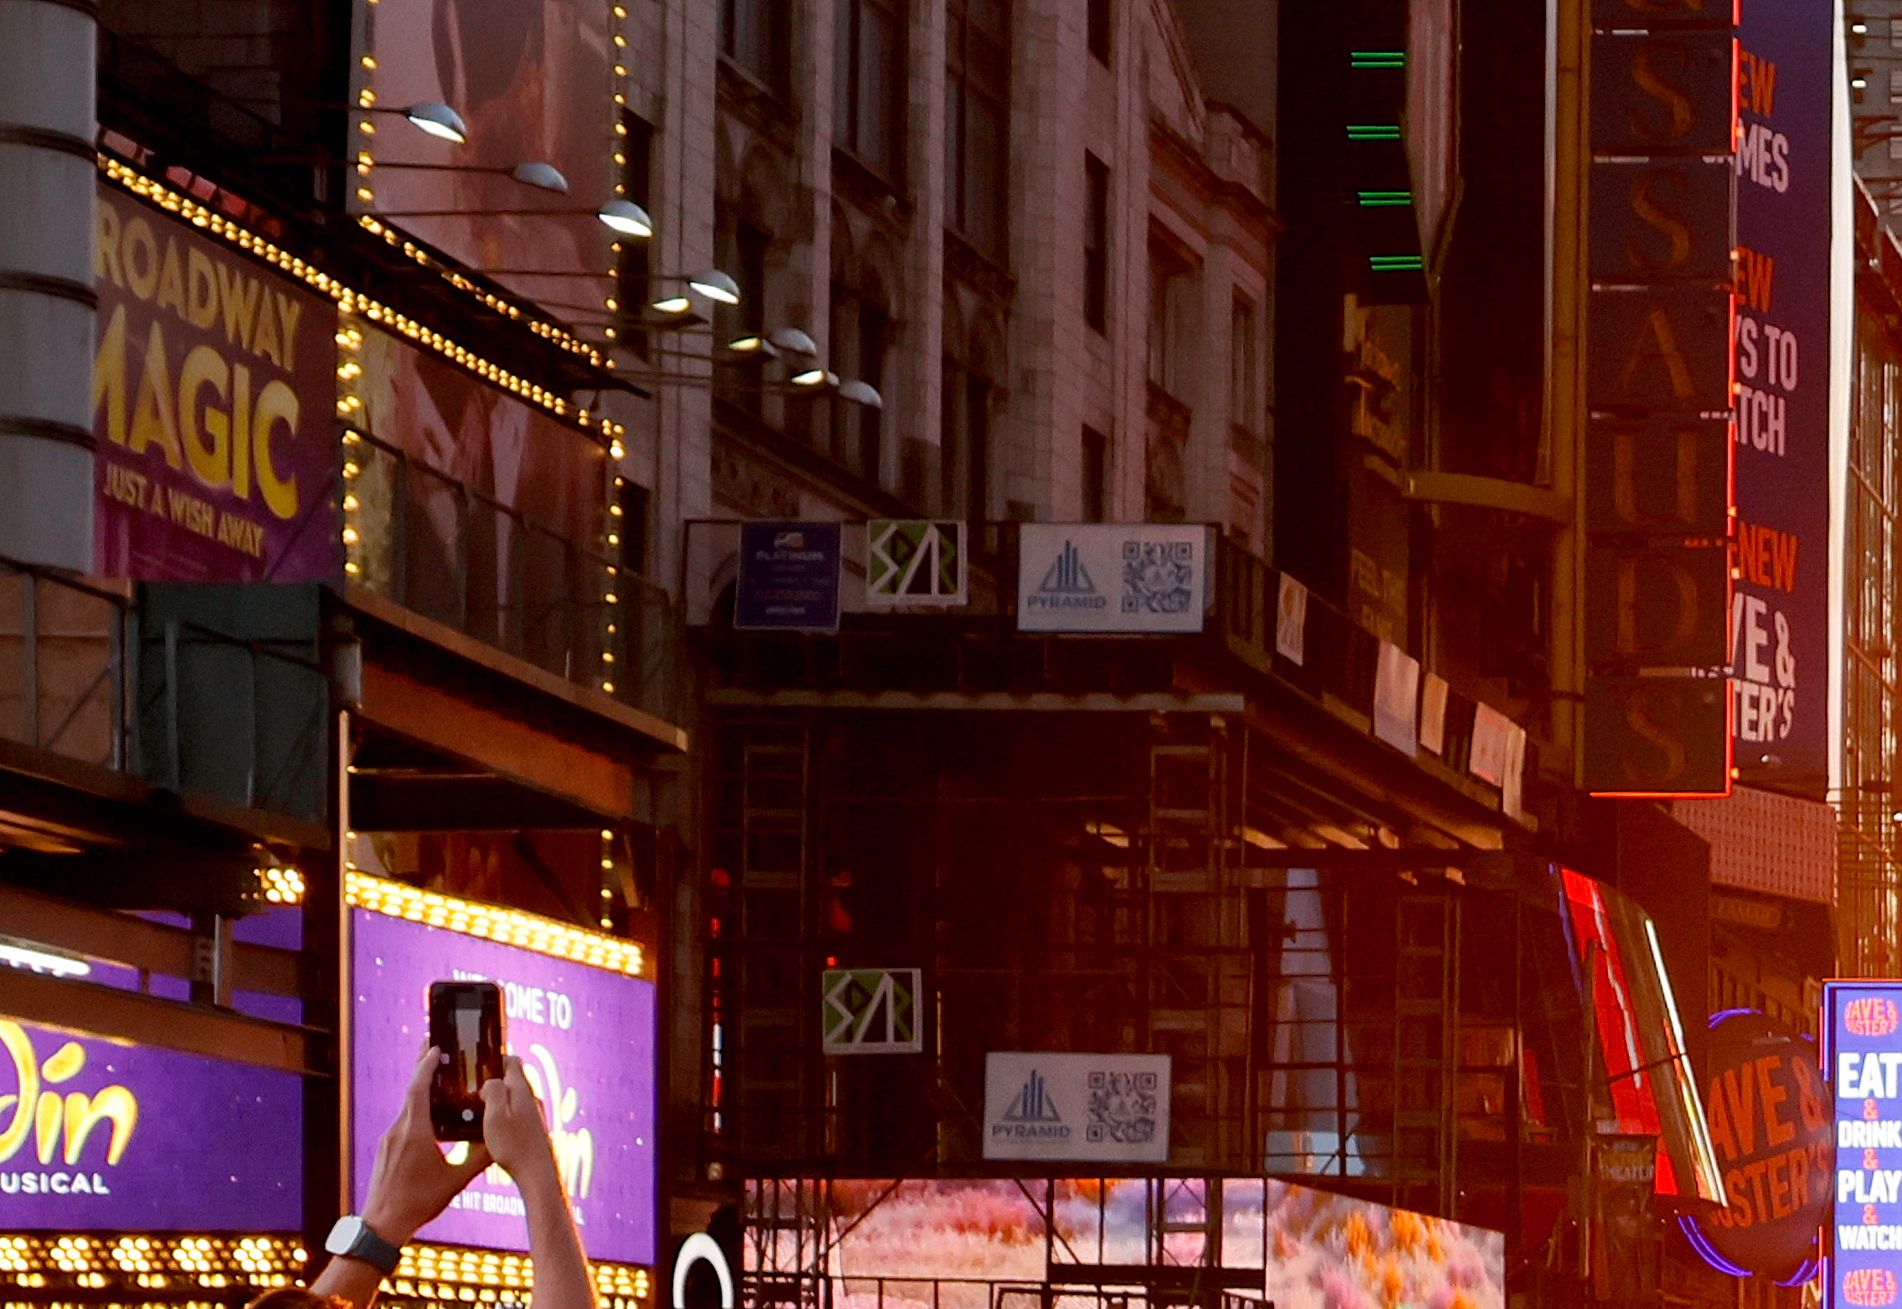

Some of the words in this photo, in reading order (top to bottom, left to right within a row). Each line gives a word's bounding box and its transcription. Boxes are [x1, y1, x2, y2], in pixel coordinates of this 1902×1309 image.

[97, 201, 300, 371] ROADWAY
[1764, 323, 1798, 392] TO
[1614, 0, 1698, 782] SSAUDS
[151, 484, 166, 518] A
[167, 487, 215, 538] WISH
[217, 512, 264, 558] AWAY
[1027, 596, 1107, 610] PYRAMID
[547, 992, 572, 1031] TO
[1705, 1055, 1793, 1161] AVE
[1862, 1098, 1880, 1120] &
[991, 1124, 1070, 1138] PYRAMID
[1838, 1120, 1902, 1148] DRINK
[1862, 1149, 1879, 1170] &
[0, 1171, 111, 1194] USICAL
[1838, 1169, 1902, 1204] PLAY
[1861, 1203, 1879, 1225] &
